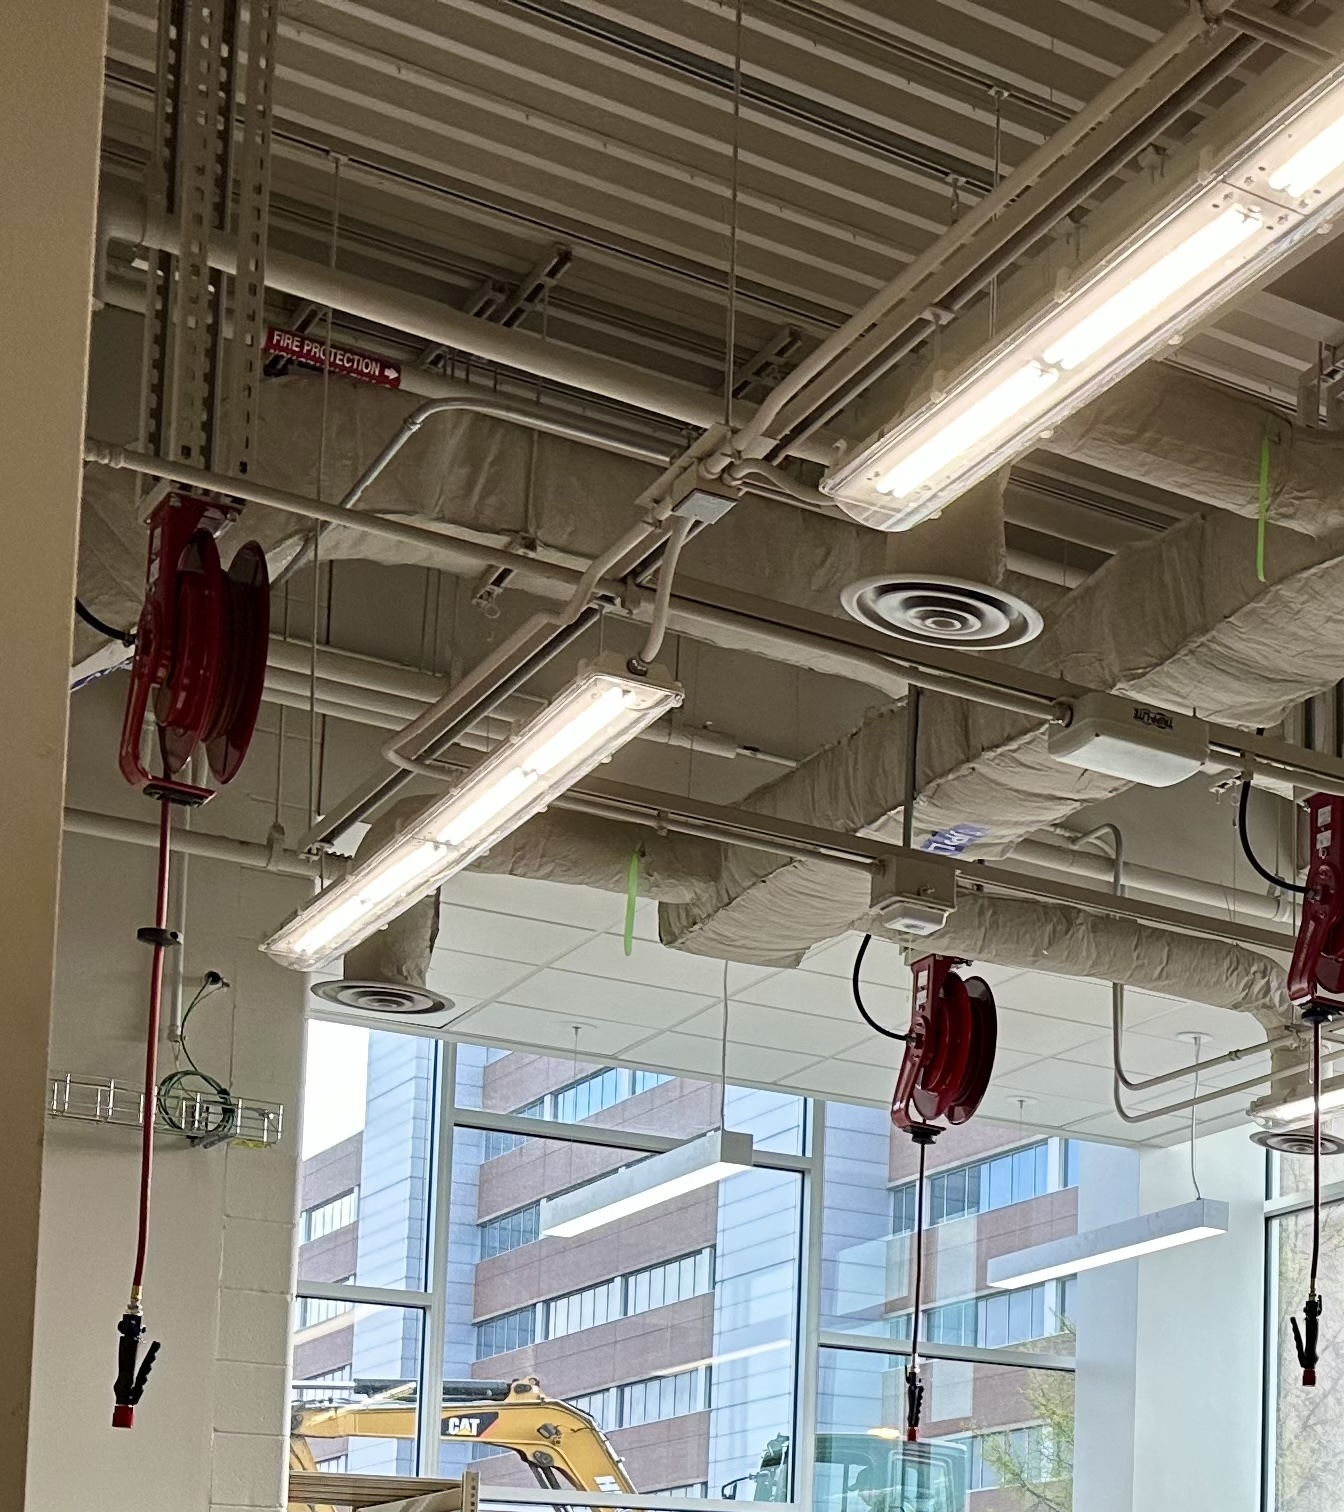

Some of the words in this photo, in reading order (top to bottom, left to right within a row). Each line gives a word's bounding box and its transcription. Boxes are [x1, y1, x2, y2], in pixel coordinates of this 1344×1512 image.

[273, 331, 300, 352] FIRE
[303, 340, 380, 376] PROTECTION
[448, 1417, 480, 1436] CAT
